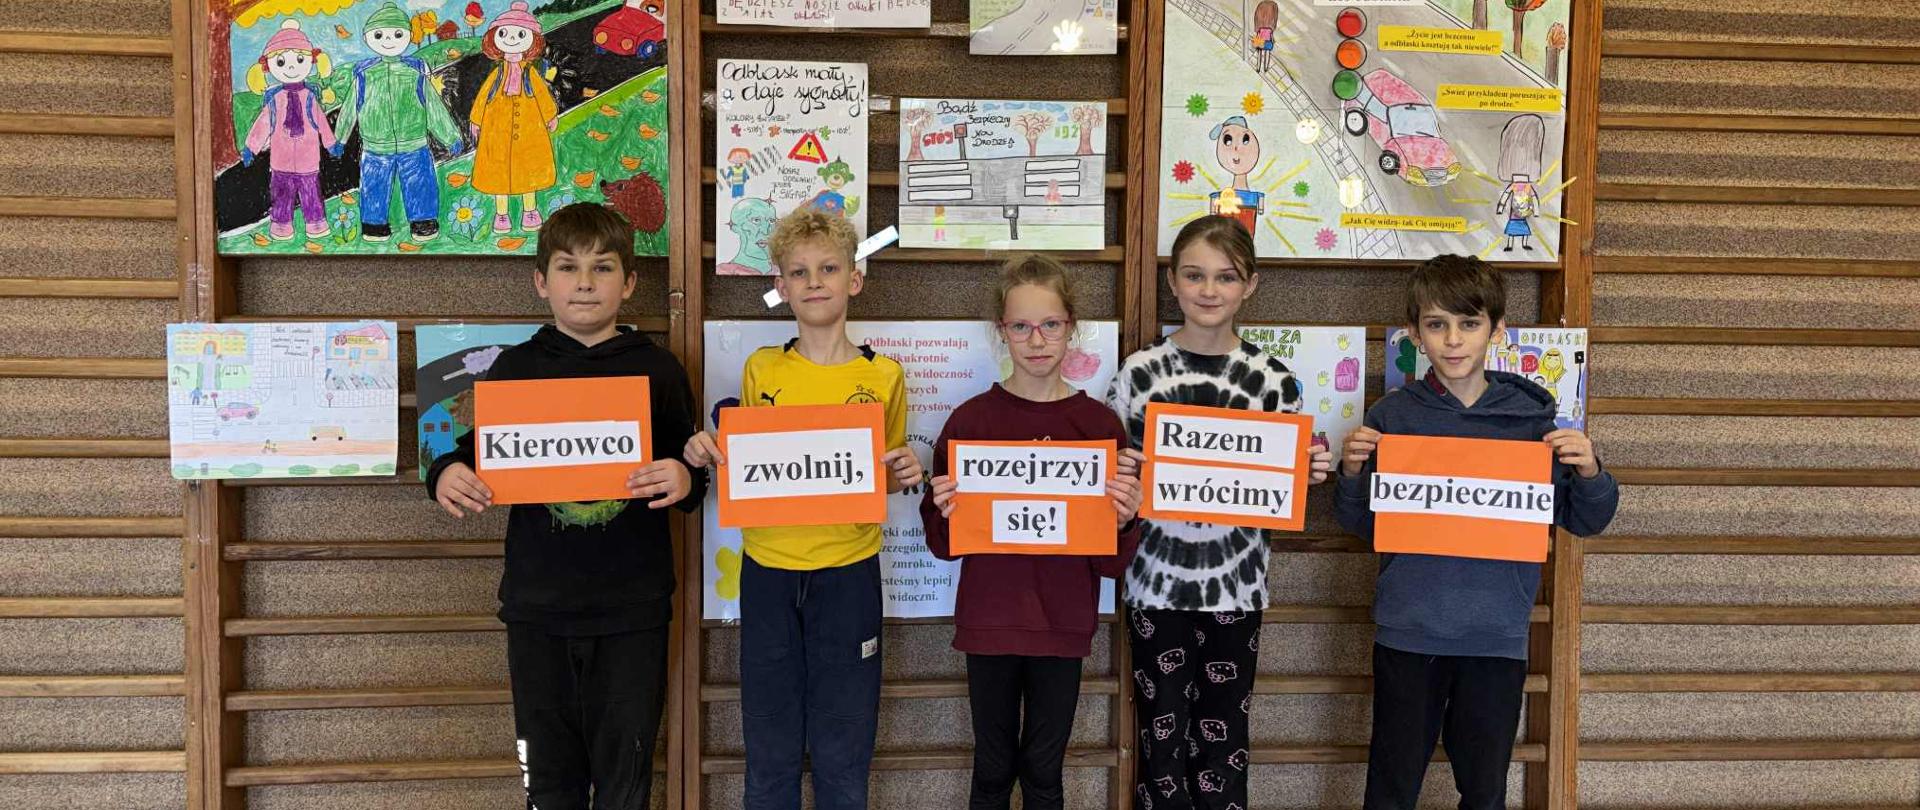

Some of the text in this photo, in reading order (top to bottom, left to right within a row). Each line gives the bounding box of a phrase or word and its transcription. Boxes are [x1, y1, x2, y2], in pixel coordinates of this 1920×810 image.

[747, 82, 790, 117] daje
[863, 338, 968, 350] Odblaski pozwalają
[1242, 329, 1302, 344] ASKI ZA
[1262, 344, 1294, 359] ASKI
[914, 367, 974, 379] widoczność
[483, 432, 634, 460] Kierowco
[1160, 421, 1264, 454] Razem
[743, 452, 864, 485] zwolnij,
[962, 453, 1099, 487] rozejrzyj
[1158, 478, 1289, 515] wrócimy
[1373, 474, 1552, 512] bezpiecznie
[883, 527, 899, 538] ęki
[1007, 507, 1057, 538] się!
[881, 573, 952, 588] esteśmy lepiej
[889, 591, 938, 602] widoczni.
